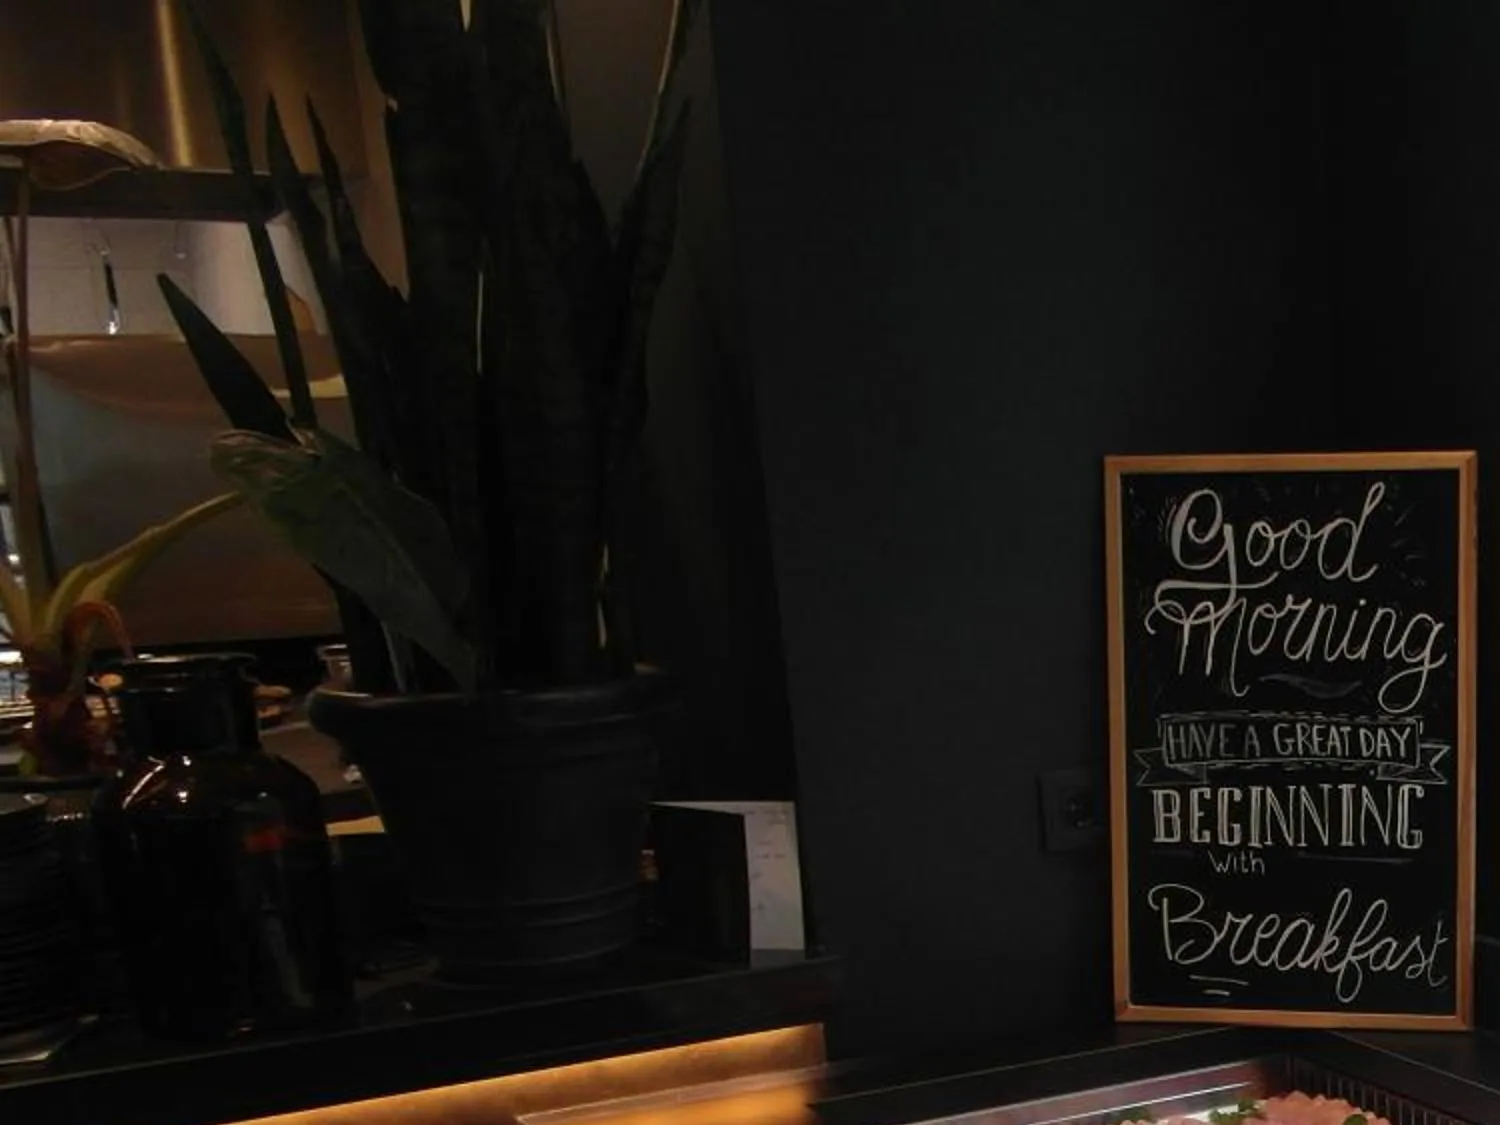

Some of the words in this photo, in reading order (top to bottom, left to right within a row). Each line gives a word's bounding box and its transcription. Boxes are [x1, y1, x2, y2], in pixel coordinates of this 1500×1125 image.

[1154, 481, 1386, 625] Good
[1144, 593, 1447, 713] Morning
[1165, 724, 1234, 760] HAVE
[1244, 724, 1261, 757] A
[1272, 722, 1352, 757] GREAT
[1359, 726, 1412, 759] DAY
[1151, 783, 1425, 849] BEGINNING
[1147, 883, 1448, 1003] Breakfast
